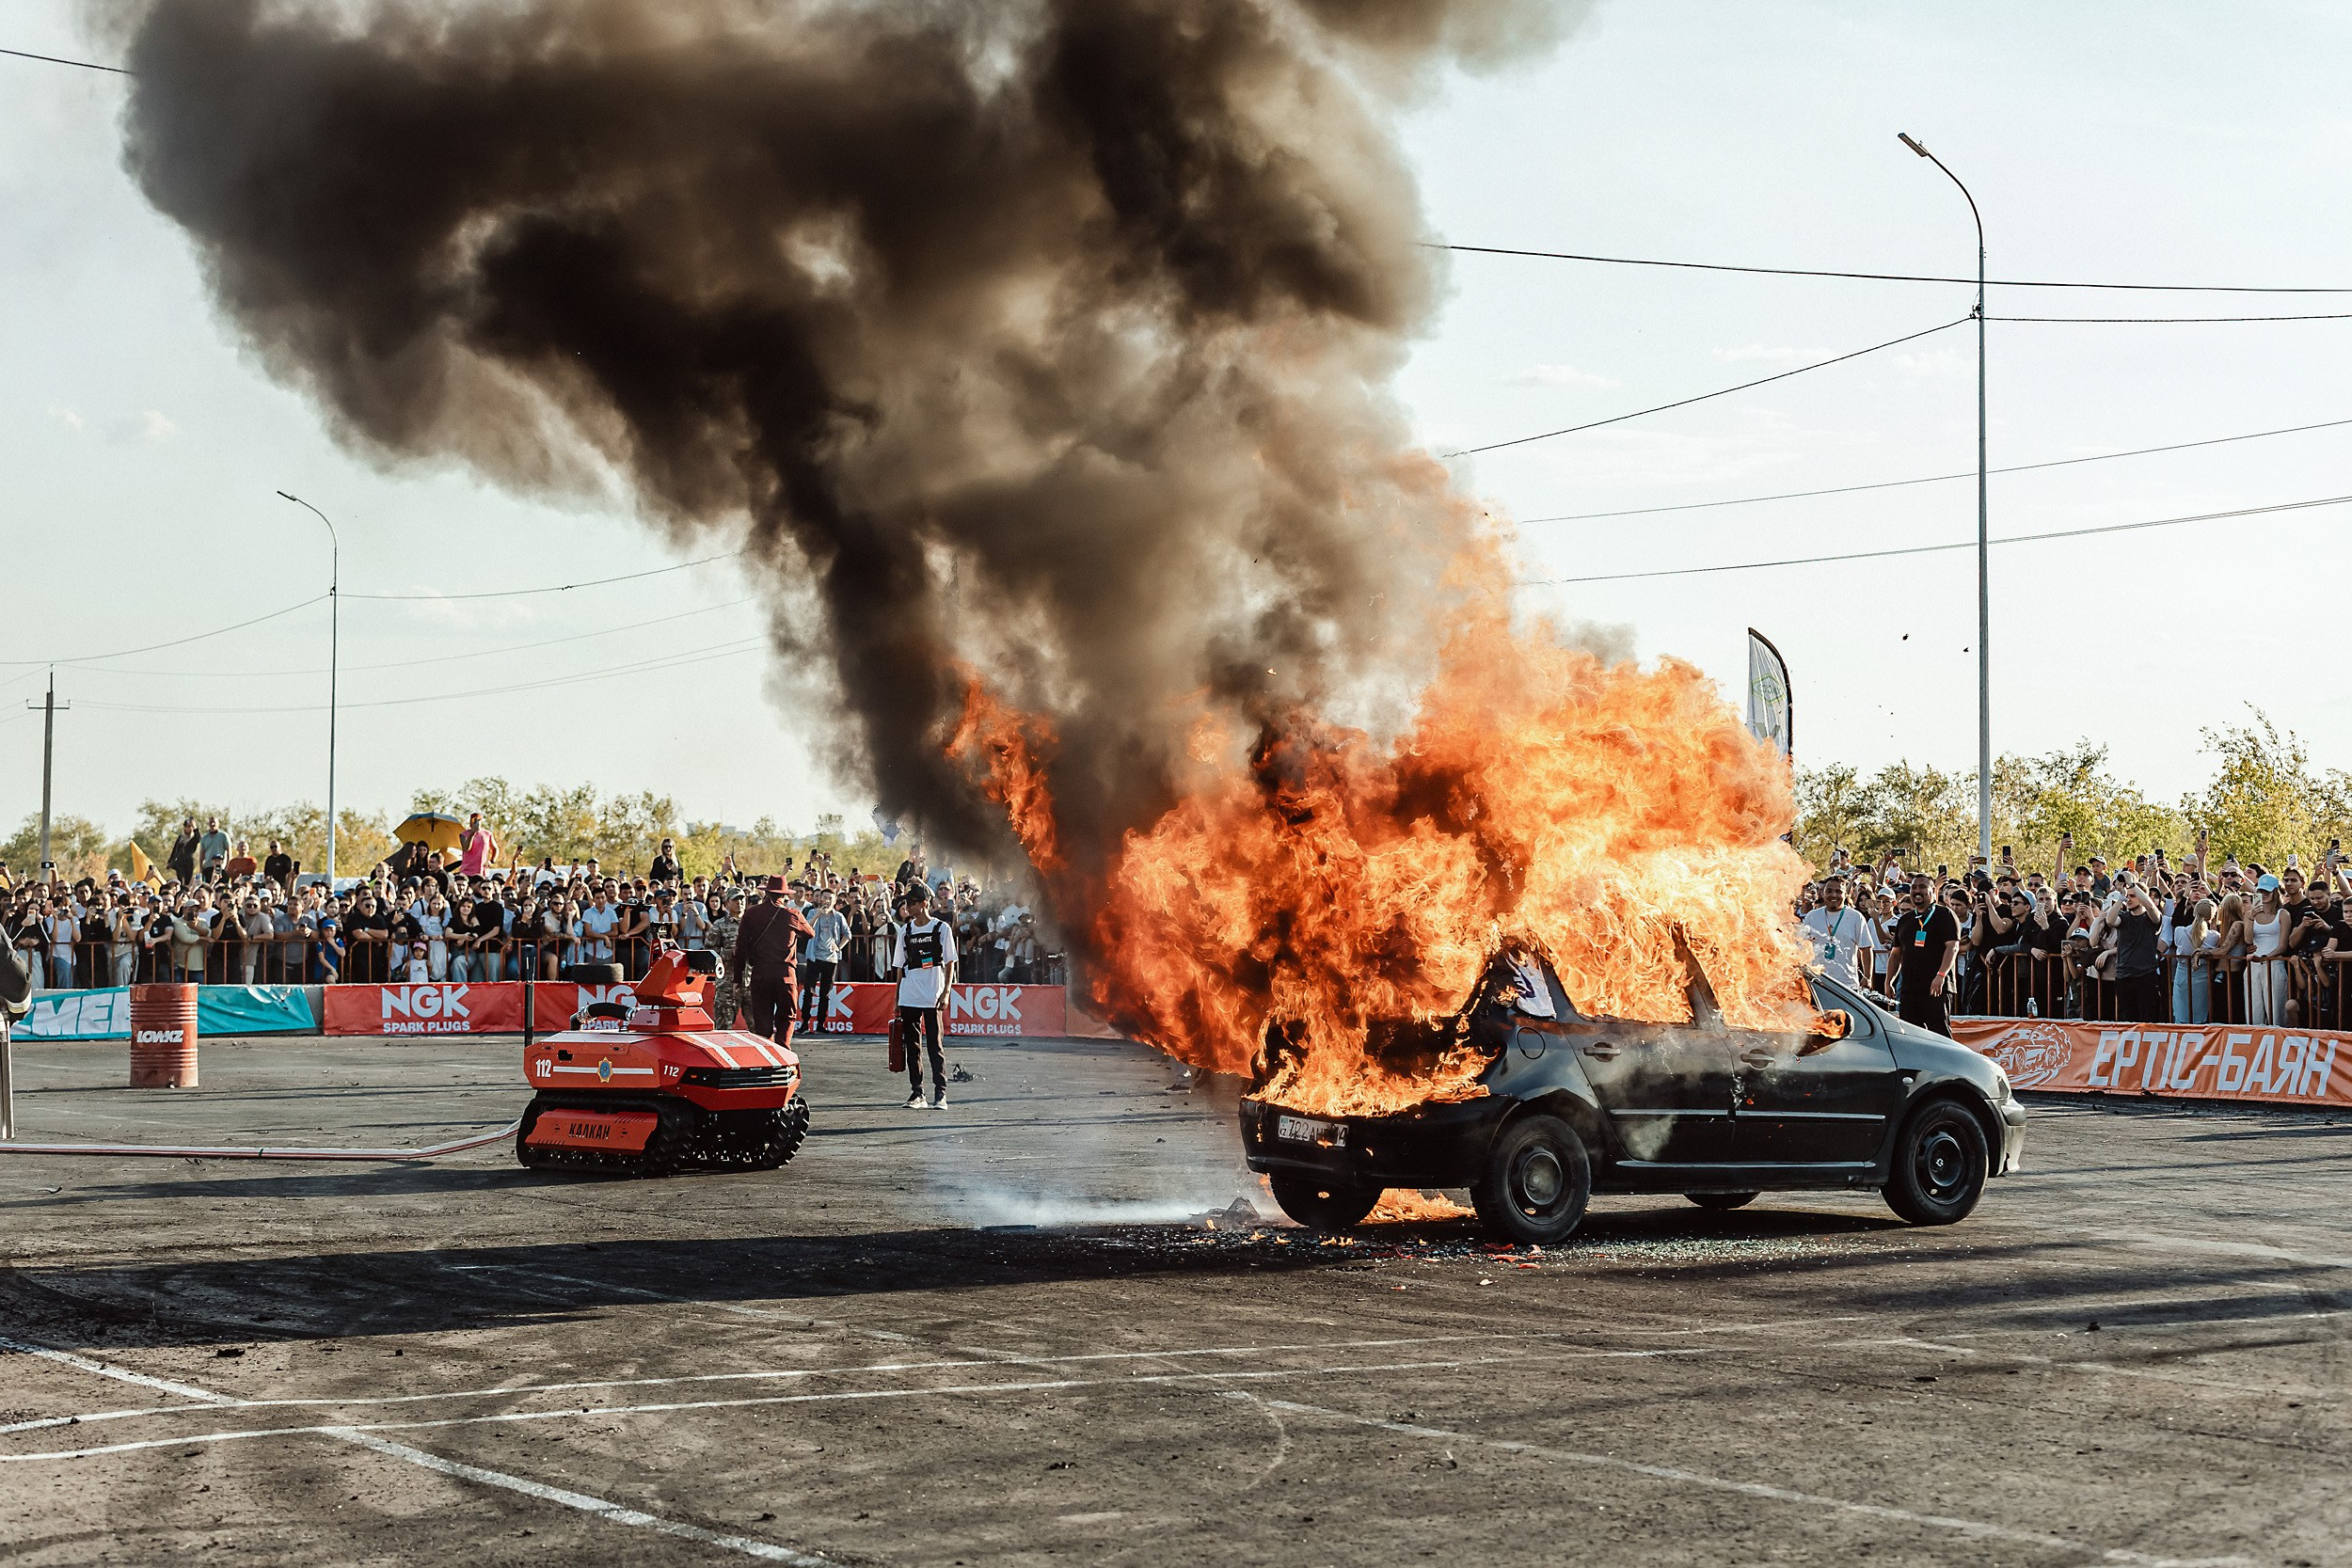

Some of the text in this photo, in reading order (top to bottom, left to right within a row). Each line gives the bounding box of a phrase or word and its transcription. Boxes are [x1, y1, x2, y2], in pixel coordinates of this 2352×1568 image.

[381, 983, 470, 1019] NGK
[949, 986, 1023, 1022] NGK
[383, 1021, 470, 1034] SPARK PLUGS
[950, 1022, 1023, 1035] SPARK PLUGS
[535, 1058, 552, 1078] 112
[663, 1065, 680, 1077] 112
[2088, 1030, 2339, 1097] ЕРТІС-БАЯН
[568, 1122, 612, 1141] КАЛКАН
